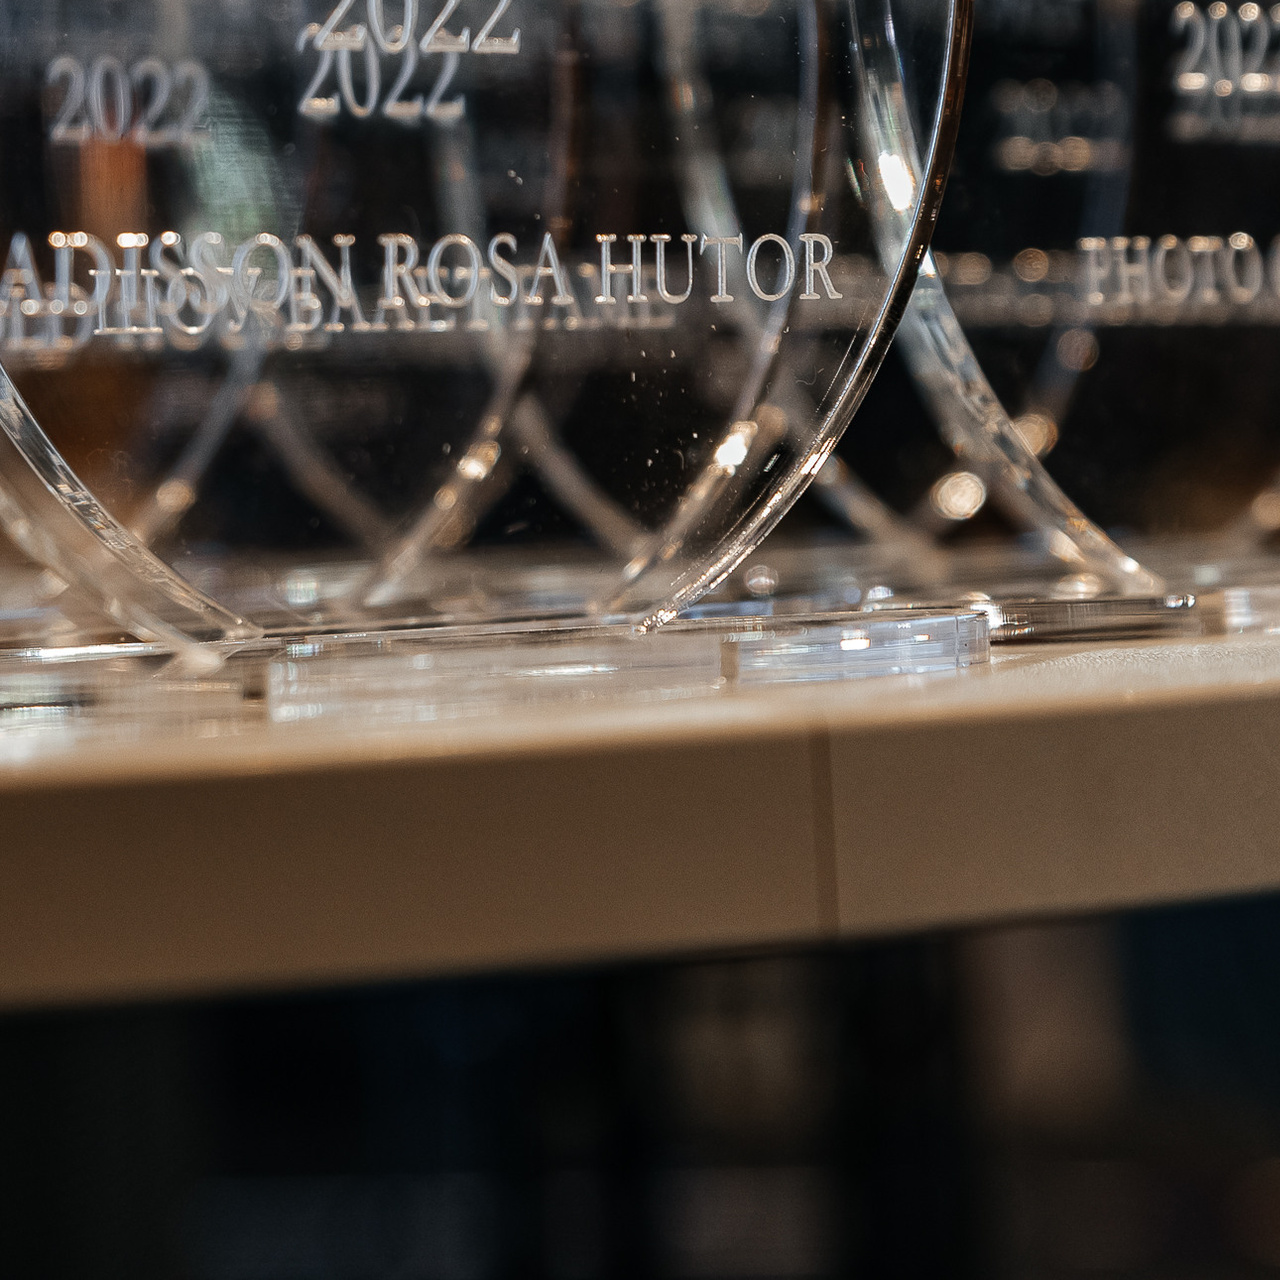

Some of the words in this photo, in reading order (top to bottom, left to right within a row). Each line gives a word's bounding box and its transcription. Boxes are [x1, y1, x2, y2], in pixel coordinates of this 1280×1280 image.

[46, 54, 212, 144] 2022
[296, 22, 467, 118] 2022
[377, 231, 575, 308] ROSA
[595, 232, 844, 305] HUTOR
